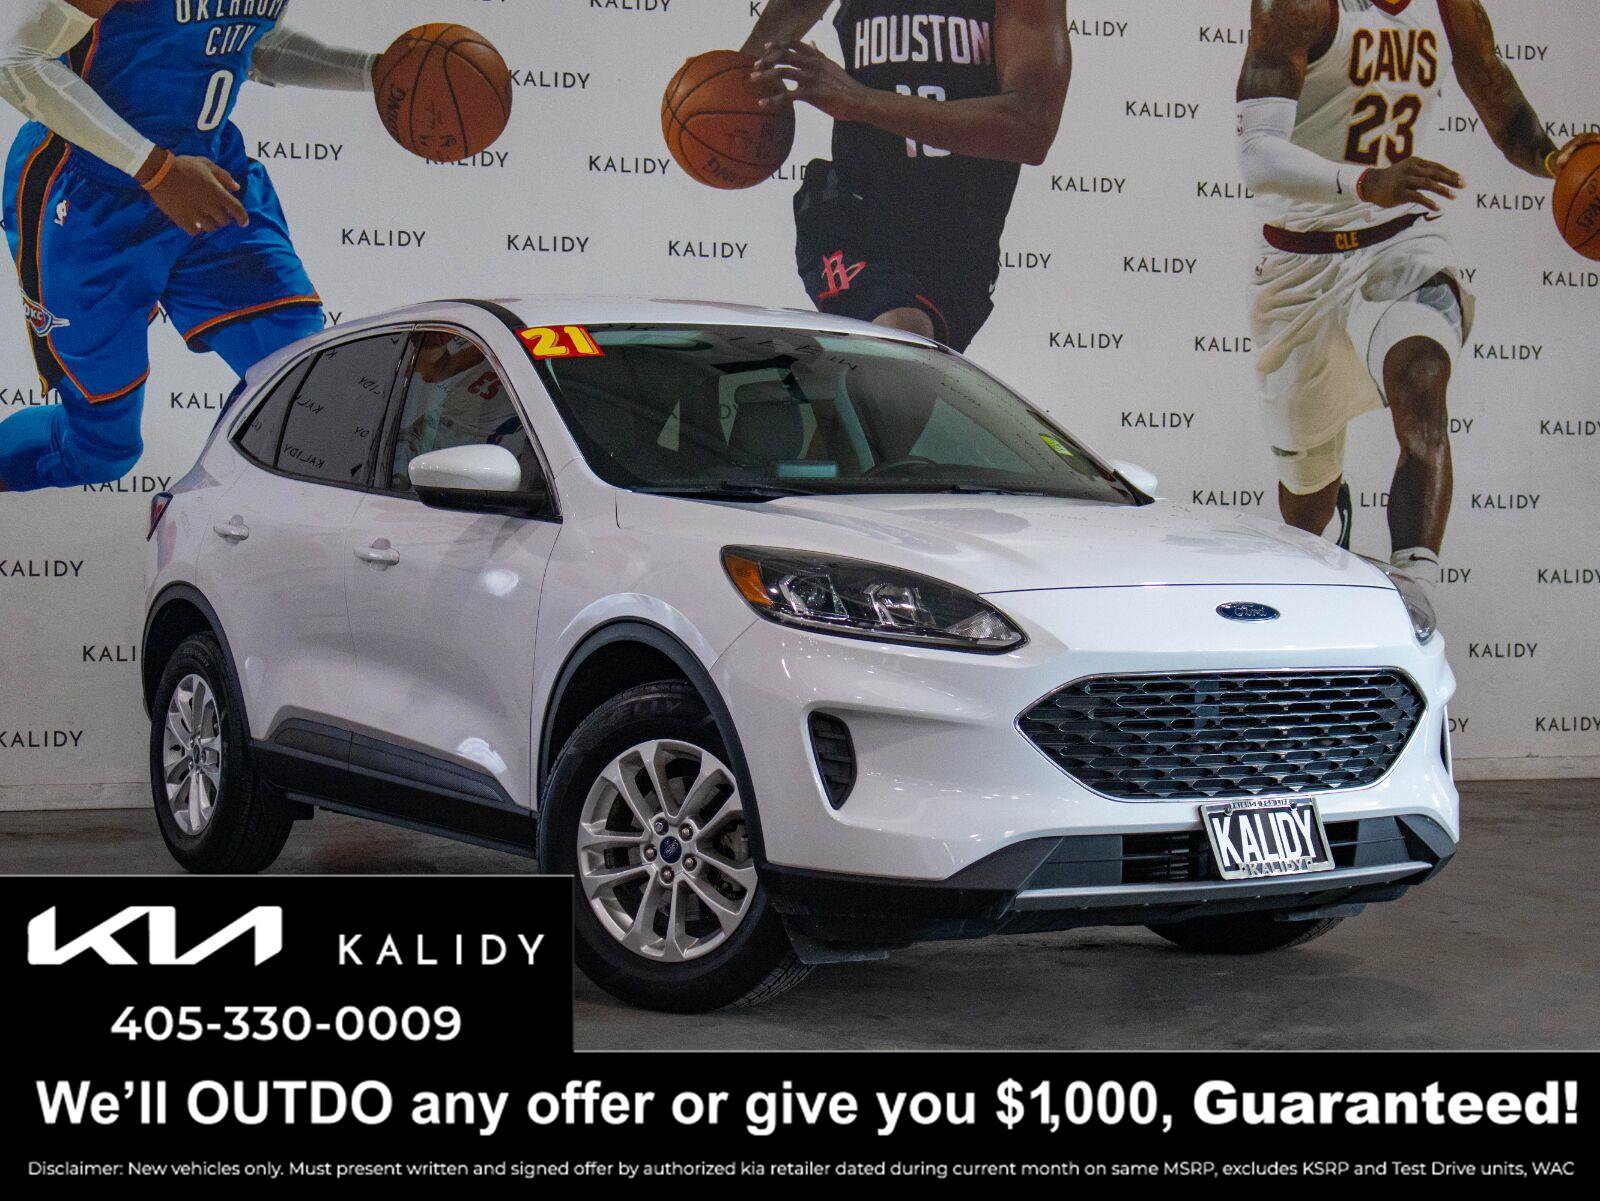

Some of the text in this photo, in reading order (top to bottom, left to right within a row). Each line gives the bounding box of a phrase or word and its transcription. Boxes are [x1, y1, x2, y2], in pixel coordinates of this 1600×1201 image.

[1068, 20, 1127, 37] ALIDY
[1200, 27, 1251, 44] KALI
[205, 25, 256, 56] CITY
[855, 15, 991, 69] HOUSTON
[1349, 28, 1437, 87] CAVS
[1494, 44, 1547, 60] ALIDY
[509, 70, 590, 89] KALIDY
[197, 70, 233, 131] 0
[1126, 101, 1199, 119] KALIDY
[1344, 93, 1421, 164] 23
[1439, 117, 1478, 132] IDY
[258, 142, 343, 161] KALIDY
[589, 156, 669, 174] KALIDY
[1052, 176, 1125, 193] KALIDY
[1477, 194, 1545, 210] KALIDY
[342, 228, 425, 247] KALIDY
[508, 234, 589, 252] KALIDY
[1335, 233, 1359, 250] CLE
[669, 241, 748, 258] KALIDY
[999, 253, 1051, 268] LIDY
[1124, 257, 1196, 274] KALIDY
[1543, 271, 1599, 287] KALID
[521, 327, 598, 357] 21
[1050, 332, 1123, 349] KALIDY
[1195, 336, 1251, 352] KALID
[1474, 344, 1542, 360] KALIDY
[171, 392, 223, 409] KALI
[1122, 412, 1194, 428] KALIDY
[1541, 420, 1600, 436] KALID
[1193, 490, 1264, 506] KALIDY
[1361, 493, 1390, 507] LID
[1472, 494, 1540, 510] KALIDY
[1440, 569, 1471, 584] IDY
[83, 645, 136, 662] KALI
[1469, 643, 1537, 658] KALIDY
[1212, 810, 1316, 867] KALIDY
[1249, 858, 1306, 876] KALIDY
